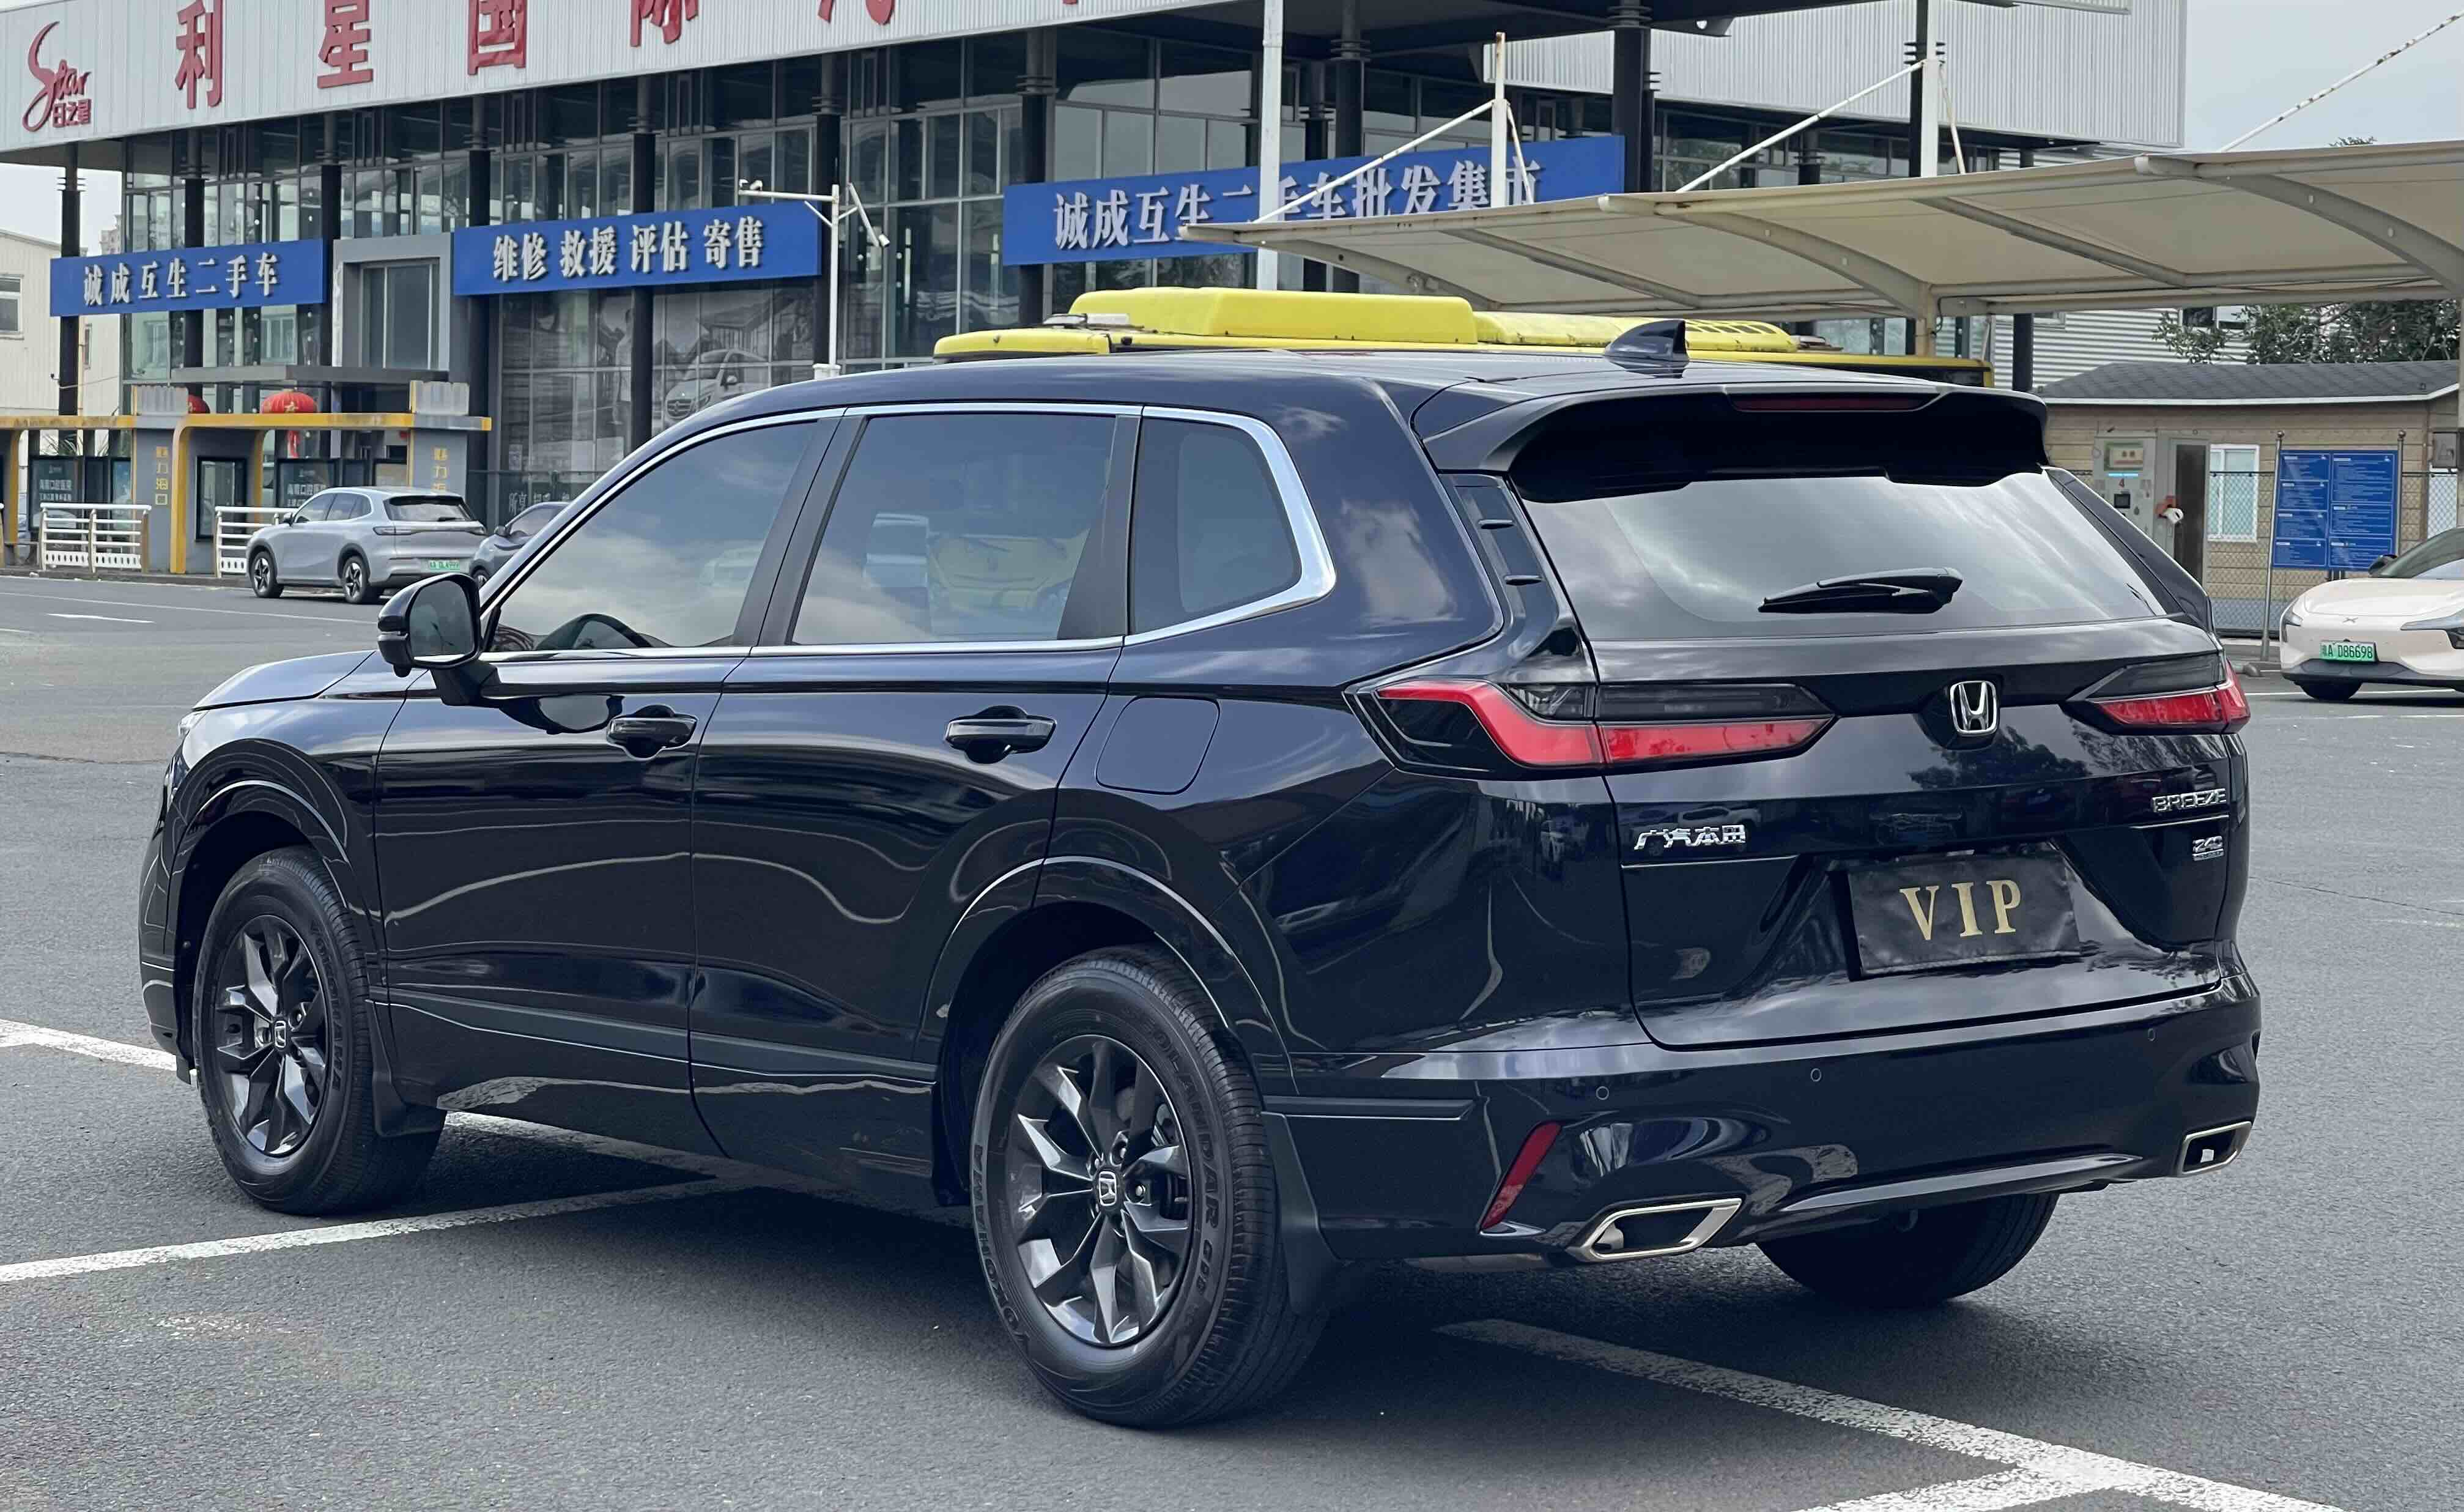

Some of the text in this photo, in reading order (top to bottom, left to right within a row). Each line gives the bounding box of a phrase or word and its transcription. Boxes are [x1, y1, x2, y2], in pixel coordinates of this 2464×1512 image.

[22, 20, 92, 132] Star
[493, 215, 763, 282] 维修 救援 评估 寄售
[83, 251, 278, 306] 诚成互生二手车
[2151, 788, 2227, 813] BREEZE
[1633, 825, 1746, 850] 广汽本田
[1899, 880, 2021, 940] VIP
